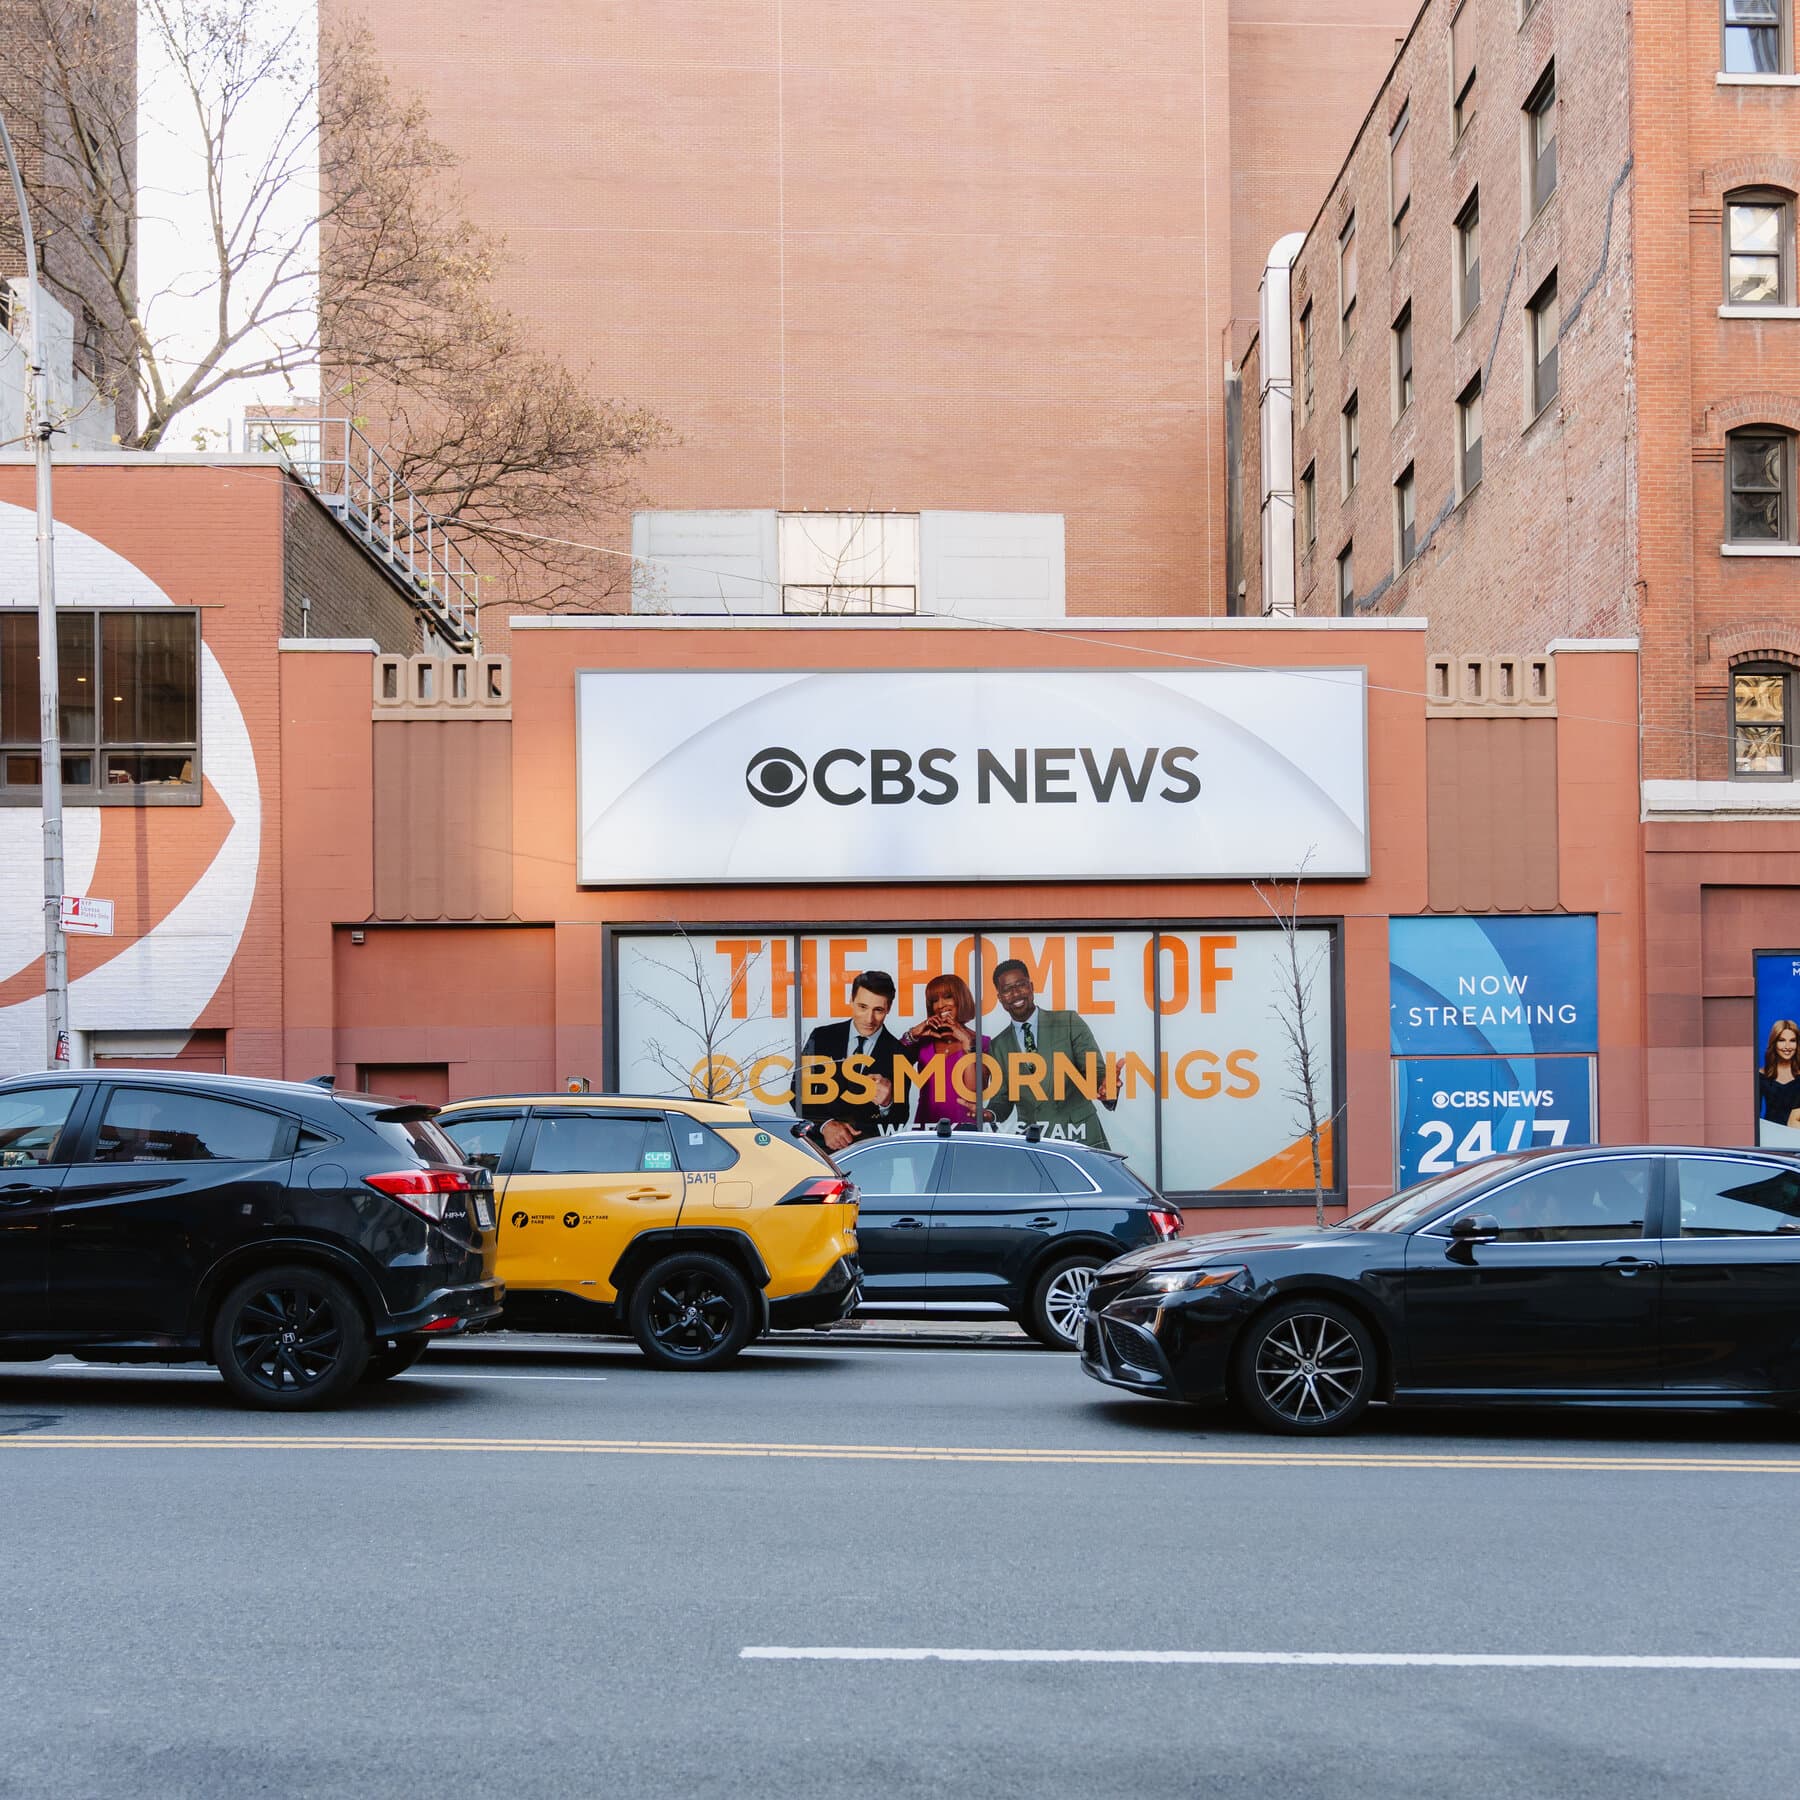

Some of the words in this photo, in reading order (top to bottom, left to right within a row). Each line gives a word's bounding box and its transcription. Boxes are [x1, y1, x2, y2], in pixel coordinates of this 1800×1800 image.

[812, 747, 959, 806] CBS
[977, 746, 1201, 804] NEWS
[715, 938, 868, 1019] THE
[897, 936, 1116, 1017] HOME
[1143, 935, 1237, 1015] OF
[1458, 975, 1529, 995] NOW
[1409, 1004, 1577, 1026] STREAMING
[749, 1053, 878, 1105] CBS
[893, 1049, 1261, 1105] MORNINGS
[1449, 1091, 1490, 1108] CBS
[1493, 1090, 1554, 1107] NEWS
[1036, 1121, 1087, 1140] 7AM
[1417, 1120, 1570, 1173] 24/7
[686, 1172, 716, 1184] 5A19
[445, 1211, 466, 1219] HR-V
